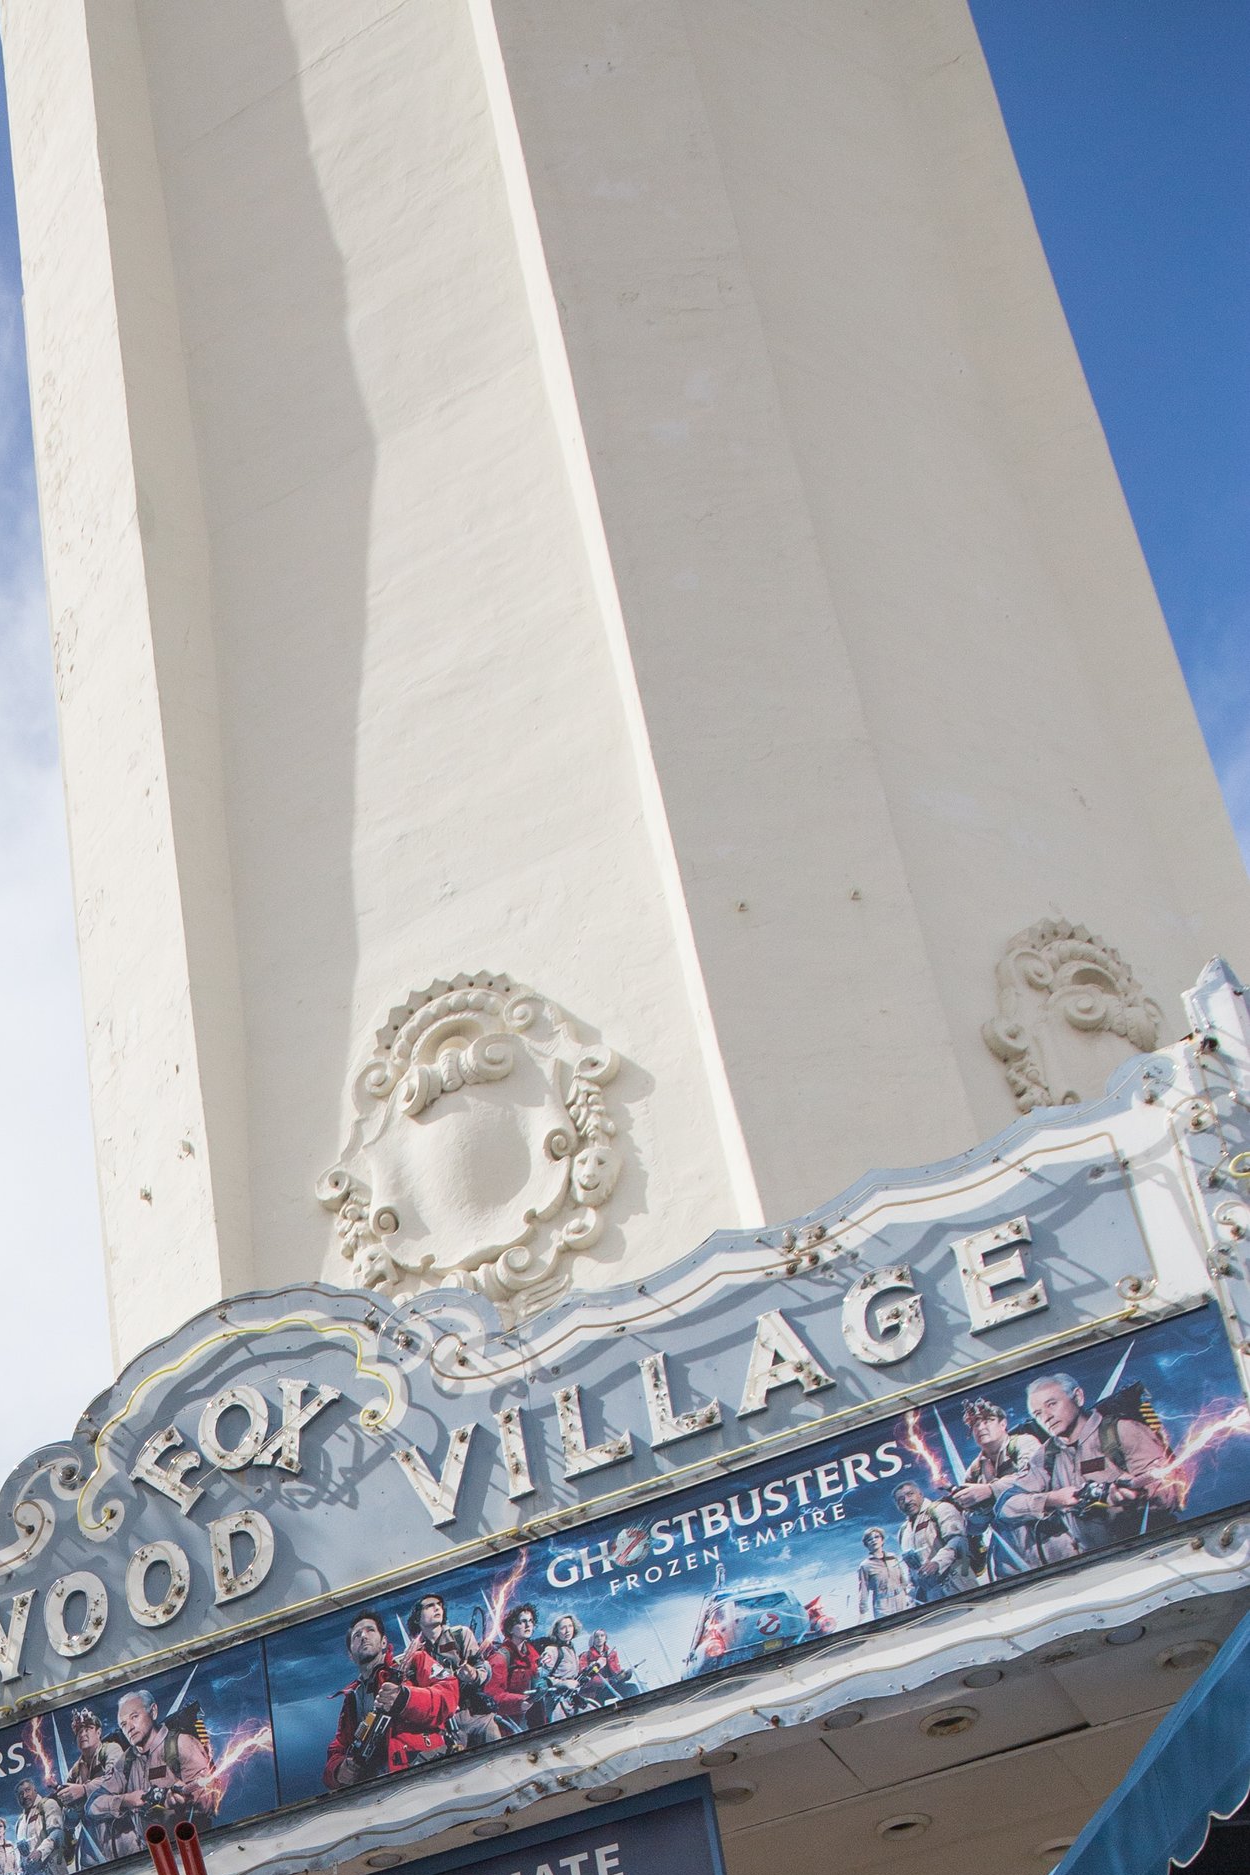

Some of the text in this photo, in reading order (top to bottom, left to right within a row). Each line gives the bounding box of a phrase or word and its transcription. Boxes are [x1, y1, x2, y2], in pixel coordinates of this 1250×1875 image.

[390, 1215, 1050, 1528] VILLAGE
[128, 1378, 343, 1517] FOX
[546, 1440, 902, 1589] GHOSTBUSTERS
[608, 1503, 846, 1596] FROZEN EMPIRE
